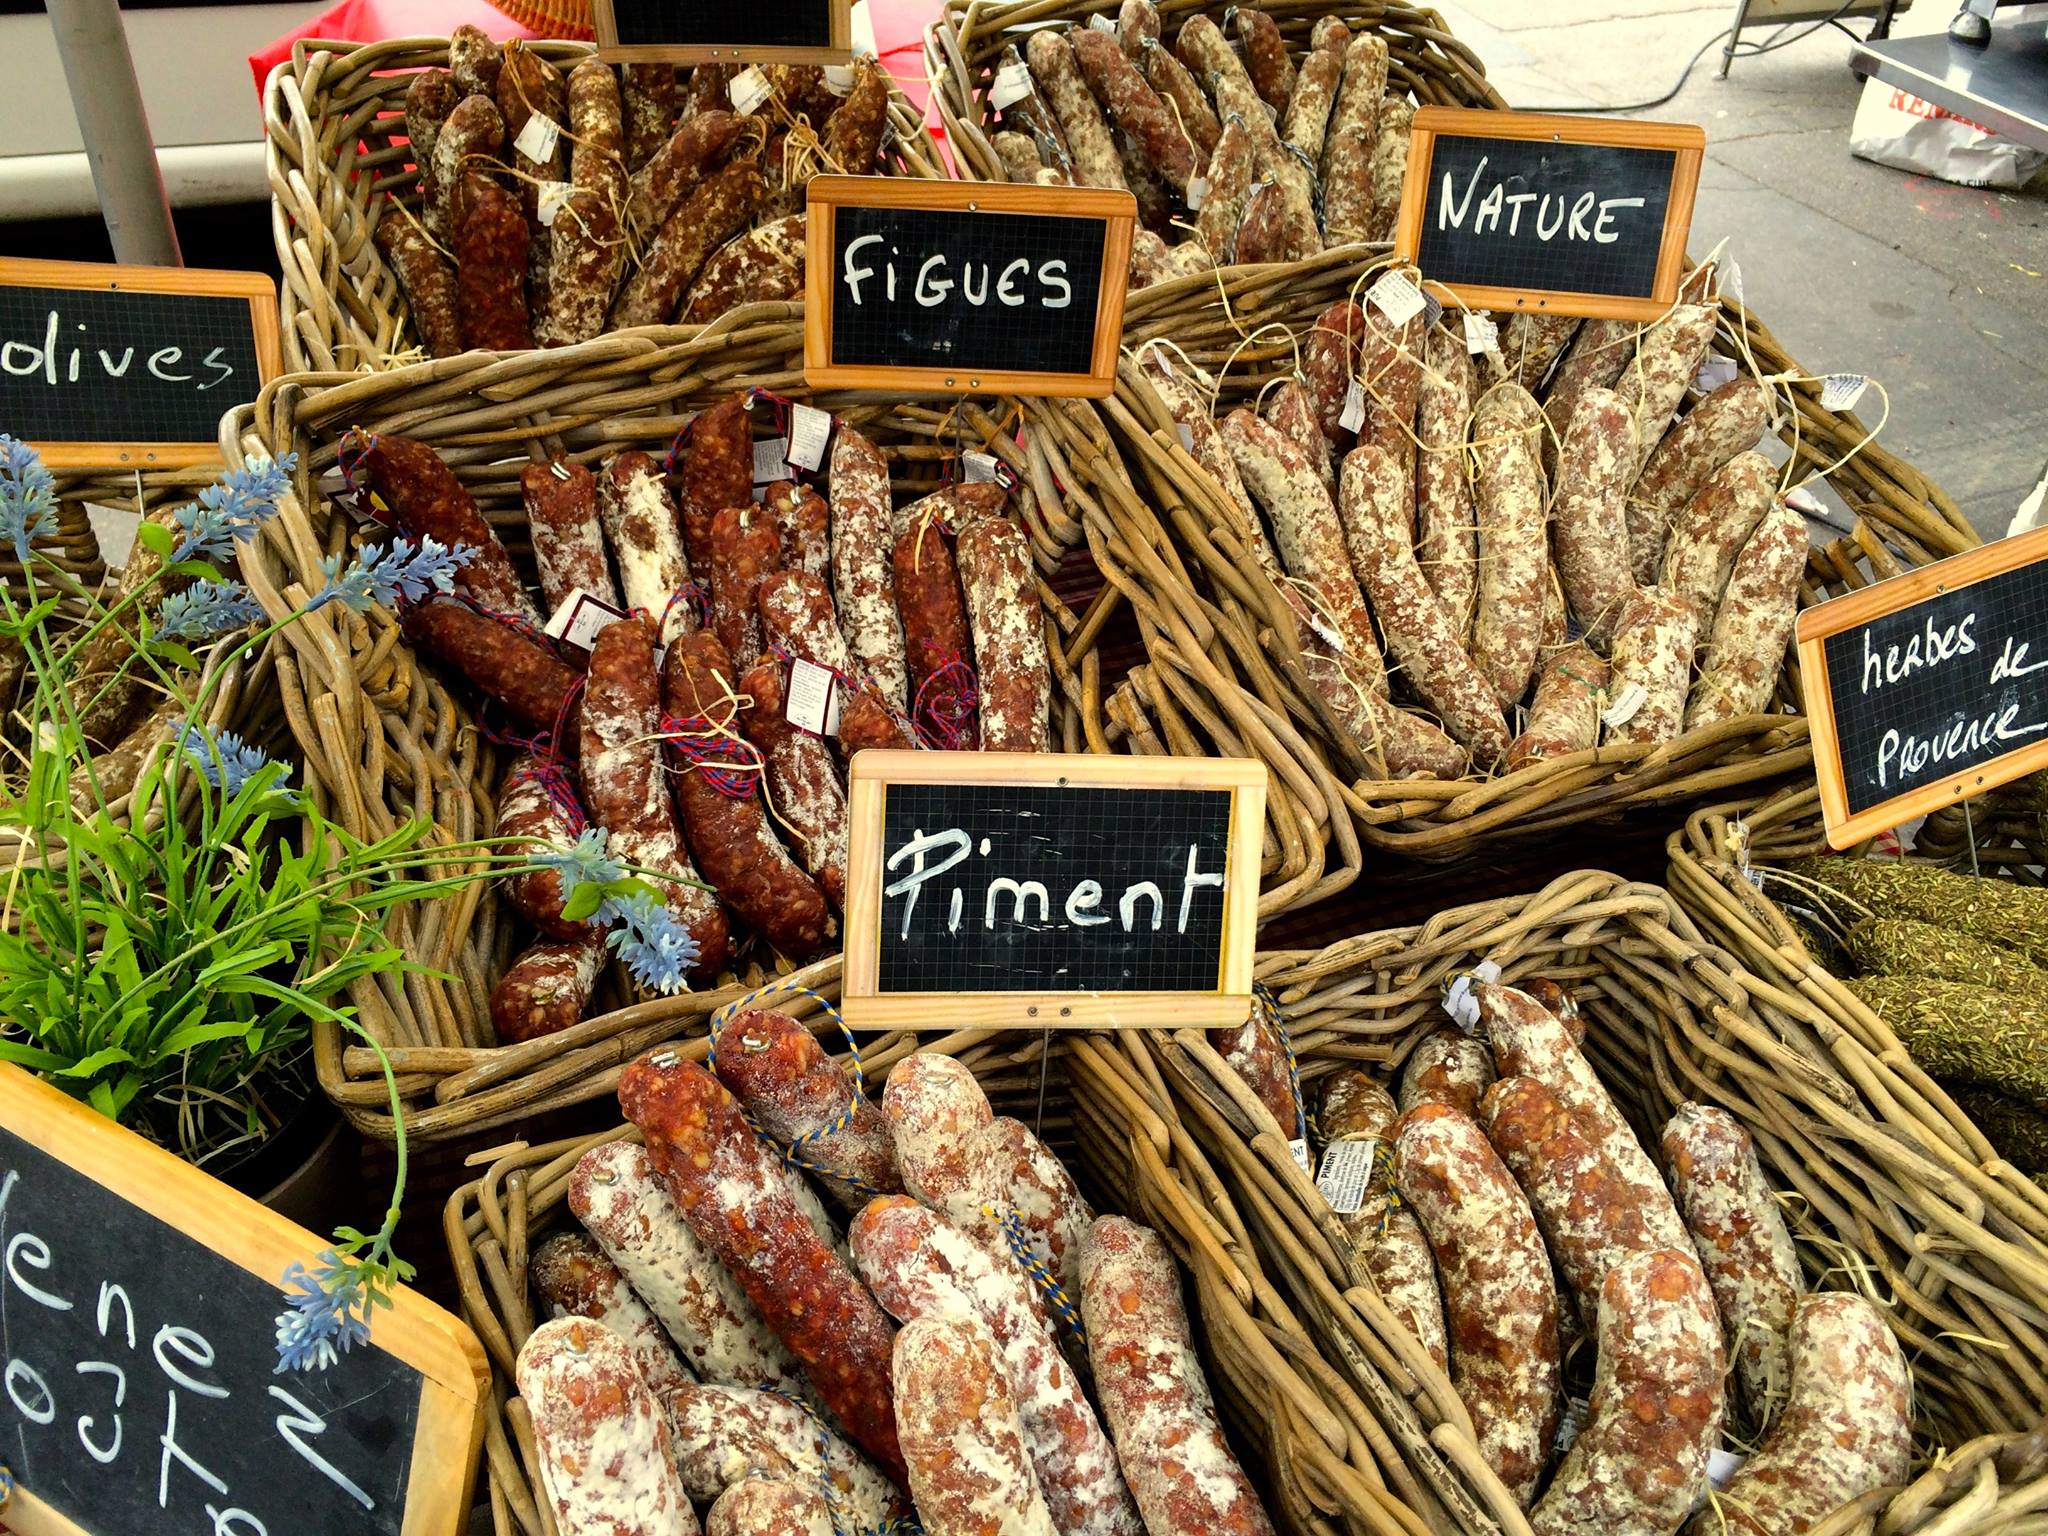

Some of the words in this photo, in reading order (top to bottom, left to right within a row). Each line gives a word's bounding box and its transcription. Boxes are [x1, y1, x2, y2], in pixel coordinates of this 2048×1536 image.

[1438, 155, 1646, 244] NATURE
[0, 309, 234, 390] olives
[1989, 635, 2048, 685] de
[884, 828, 1224, 941] Piment
[1320, 1151, 1338, 1179] PIMENT
